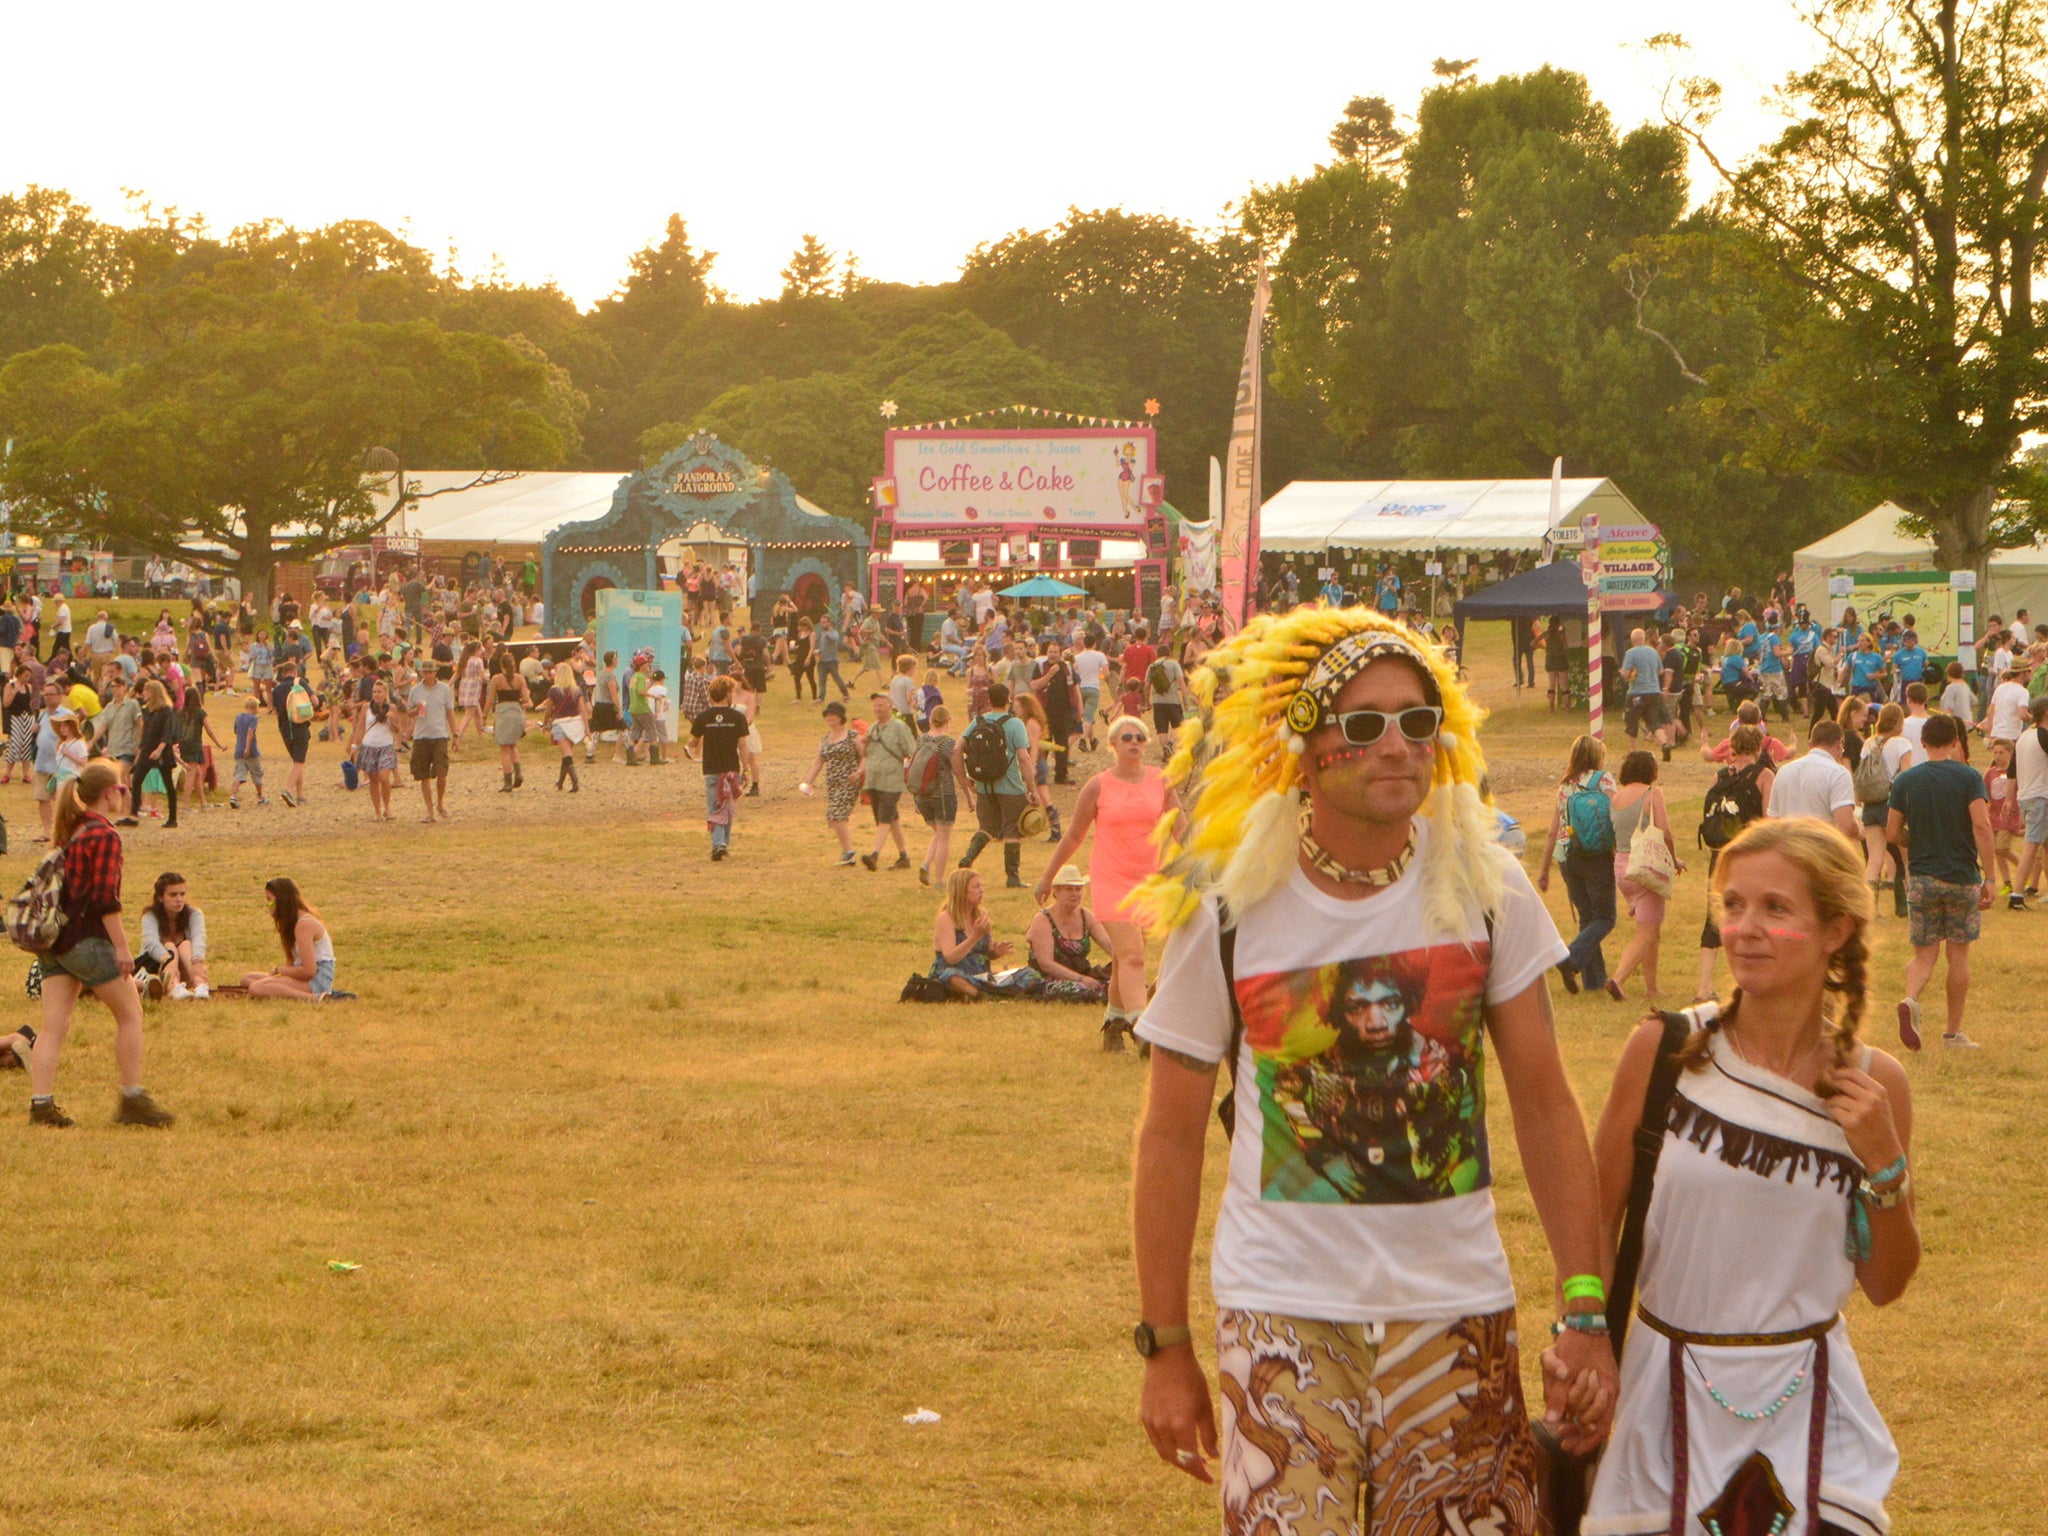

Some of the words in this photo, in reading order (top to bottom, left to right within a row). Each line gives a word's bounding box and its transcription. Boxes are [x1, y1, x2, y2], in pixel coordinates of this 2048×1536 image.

[918, 442, 935, 454] Ice
[939, 441, 966, 454] Cold
[970, 441, 1029, 454] Smoothies
[919, 463, 994, 492] Coffee
[999, 471, 1013, 491] &
[1018, 465, 1075, 491] Cake
[673, 481, 735, 493] PLAYGROUND
[1552, 529, 1579, 540] TOILETS
[1609, 528, 1649, 538] Alcove
[1603, 562, 1654, 573] VILLAGE
